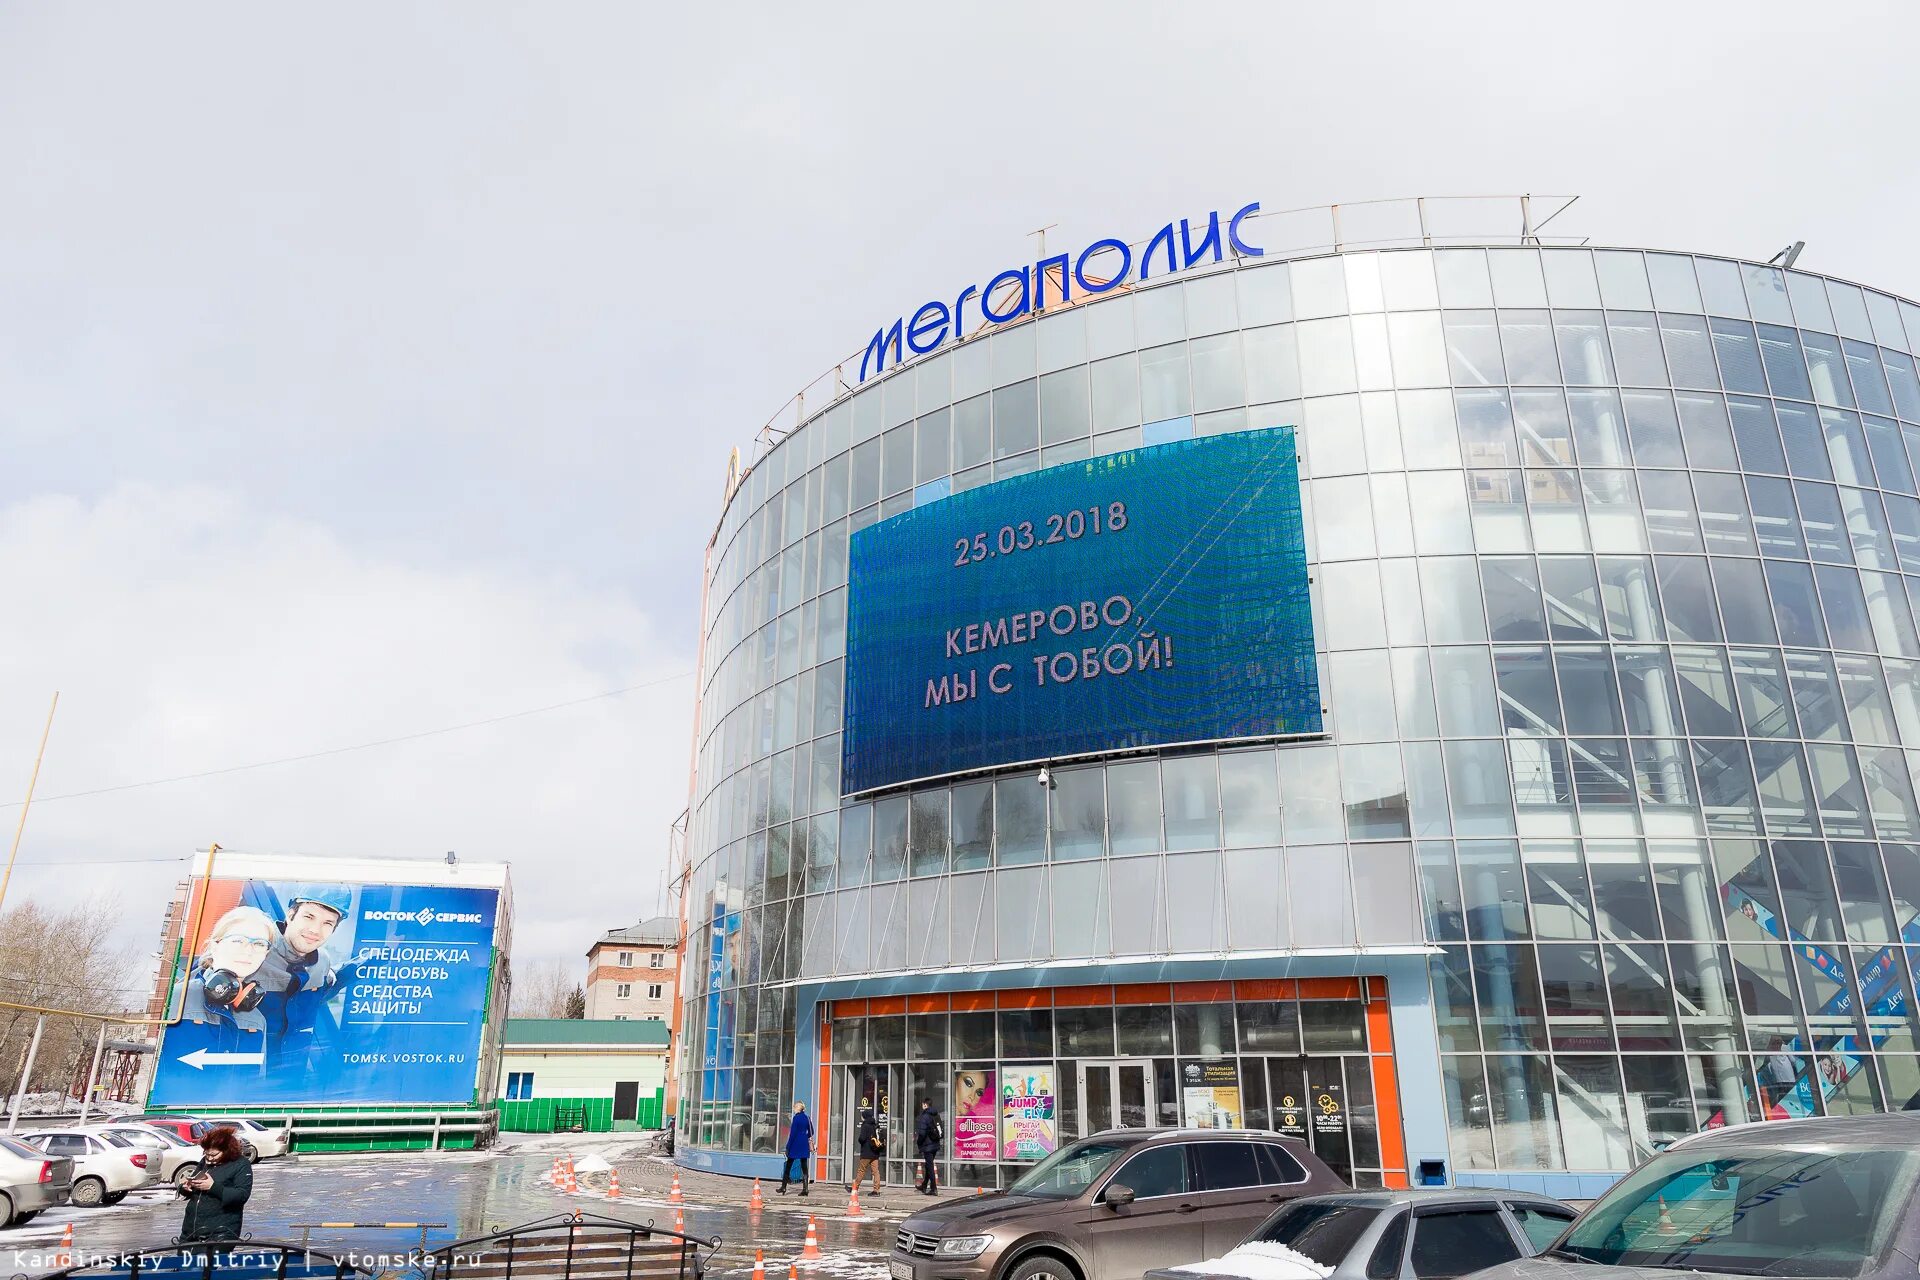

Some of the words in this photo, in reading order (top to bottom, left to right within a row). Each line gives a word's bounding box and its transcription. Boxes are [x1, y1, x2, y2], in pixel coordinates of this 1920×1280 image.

[953, 501, 1129, 567] 25.03.2018
[946, 594, 1144, 658] КЕМЕРОВО,
[924, 669, 977, 708] МЫ
[988, 663, 1013, 694] С
[1033, 630, 1174, 687] ТОБОЙ!
[364, 910, 416, 922] ВОСТОК
[435, 913, 482, 924] СЕРВИС
[358, 947, 471, 964] СПЕЦОДЕЖДА
[355, 965, 449, 981] СПЕЦОБУВЬ
[352, 984, 434, 1000] СРЕДСТВА
[349, 1001, 422, 1017] ЗАЩИТЫ
[342, 1053, 466, 1064] TOMSK.VOSTOK.RU
[1024, 1108, 1045, 1119] FLY
[1016, 1131, 1038, 1139] ИГРАЙ
[1017, 1141, 1039, 1150] ЛЕТАЙ
